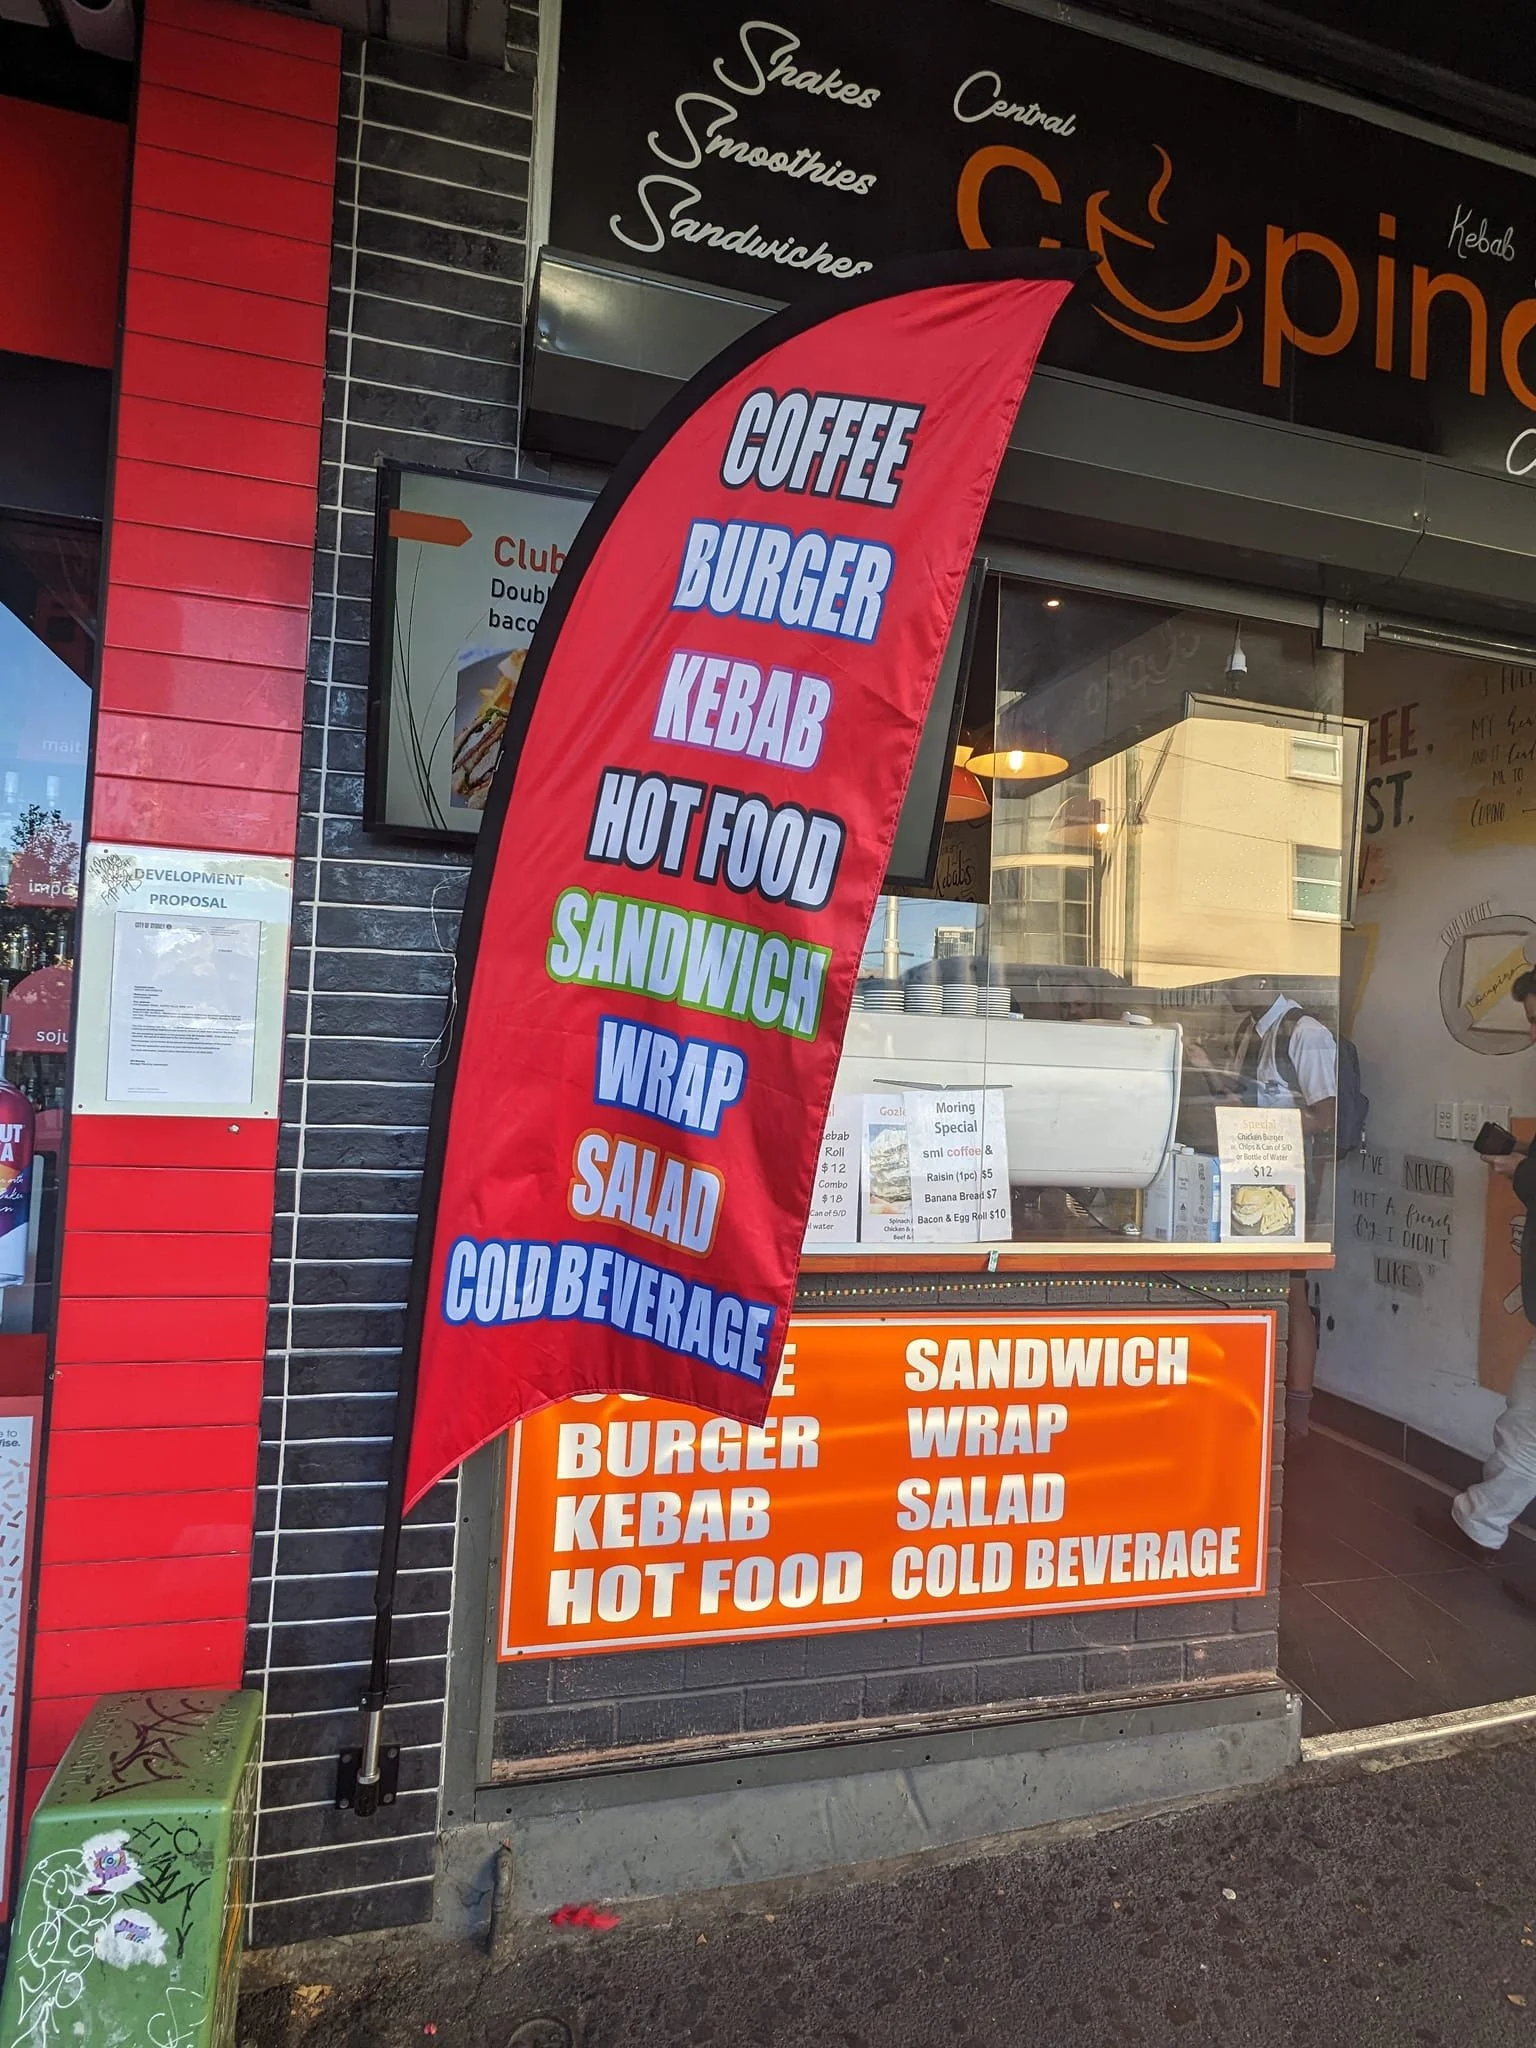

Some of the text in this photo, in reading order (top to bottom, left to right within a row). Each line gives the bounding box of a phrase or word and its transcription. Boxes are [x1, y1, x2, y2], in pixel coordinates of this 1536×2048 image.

[713, 20, 880, 109] Shakes
[953, 71, 1076, 137] Central
[648, 92, 877, 195] Smoothies
[1448, 204, 1515, 260] Kebab
[721, 387, 925, 508] COFFEE
[494, 535, 567, 574] Club
[673, 519, 895, 645] BURGER
[650, 649, 832, 771] KEBAB
[585, 767, 846, 911] HOT FOOD
[134, 868, 245, 886] DEVELOPMENT
[150, 894, 227, 909] PROPOSAL
[547, 887, 832, 1042] SANDWICH
[595, 1016, 748, 1136] WRAP
[934, 1120, 978, 1136] Special
[936, 1101, 976, 1115] Moring
[822, 1130, 850, 1141] ebab
[825, 1147, 845, 1157] Roll
[923, 1144, 993, 1158] sml coffee &
[1237, 1132, 1284, 1142] Chicken Burger
[1244, 1153, 1262, 1161] Bottle
[1269, 1153, 1288, 1161] Water
[568, 1129, 725, 1258] SALAD
[818, 1180, 848, 1189] Combo
[927, 1168, 993, 1182] Raisin (1pc) $5
[1253, 1164, 1273, 1178] $12
[1404, 1160, 1454, 1194] NEVER
[917, 1208, 1006, 1224] Bacon & Egg Roll $10
[925, 1188, 997, 1203] Banana Bread $7
[444, 1236, 552, 1326] COLD
[551, 1241, 776, 1385] BEVERAGE
[905, 1336, 1190, 1391] SANDWICH
[556, 1403, 1068, 1479] BURGER WRAP
[553, 1473, 1065, 1552] KEBAB SALAD
[547, 1526, 1241, 1626] HOT FOOD COLD BEVERAGE
